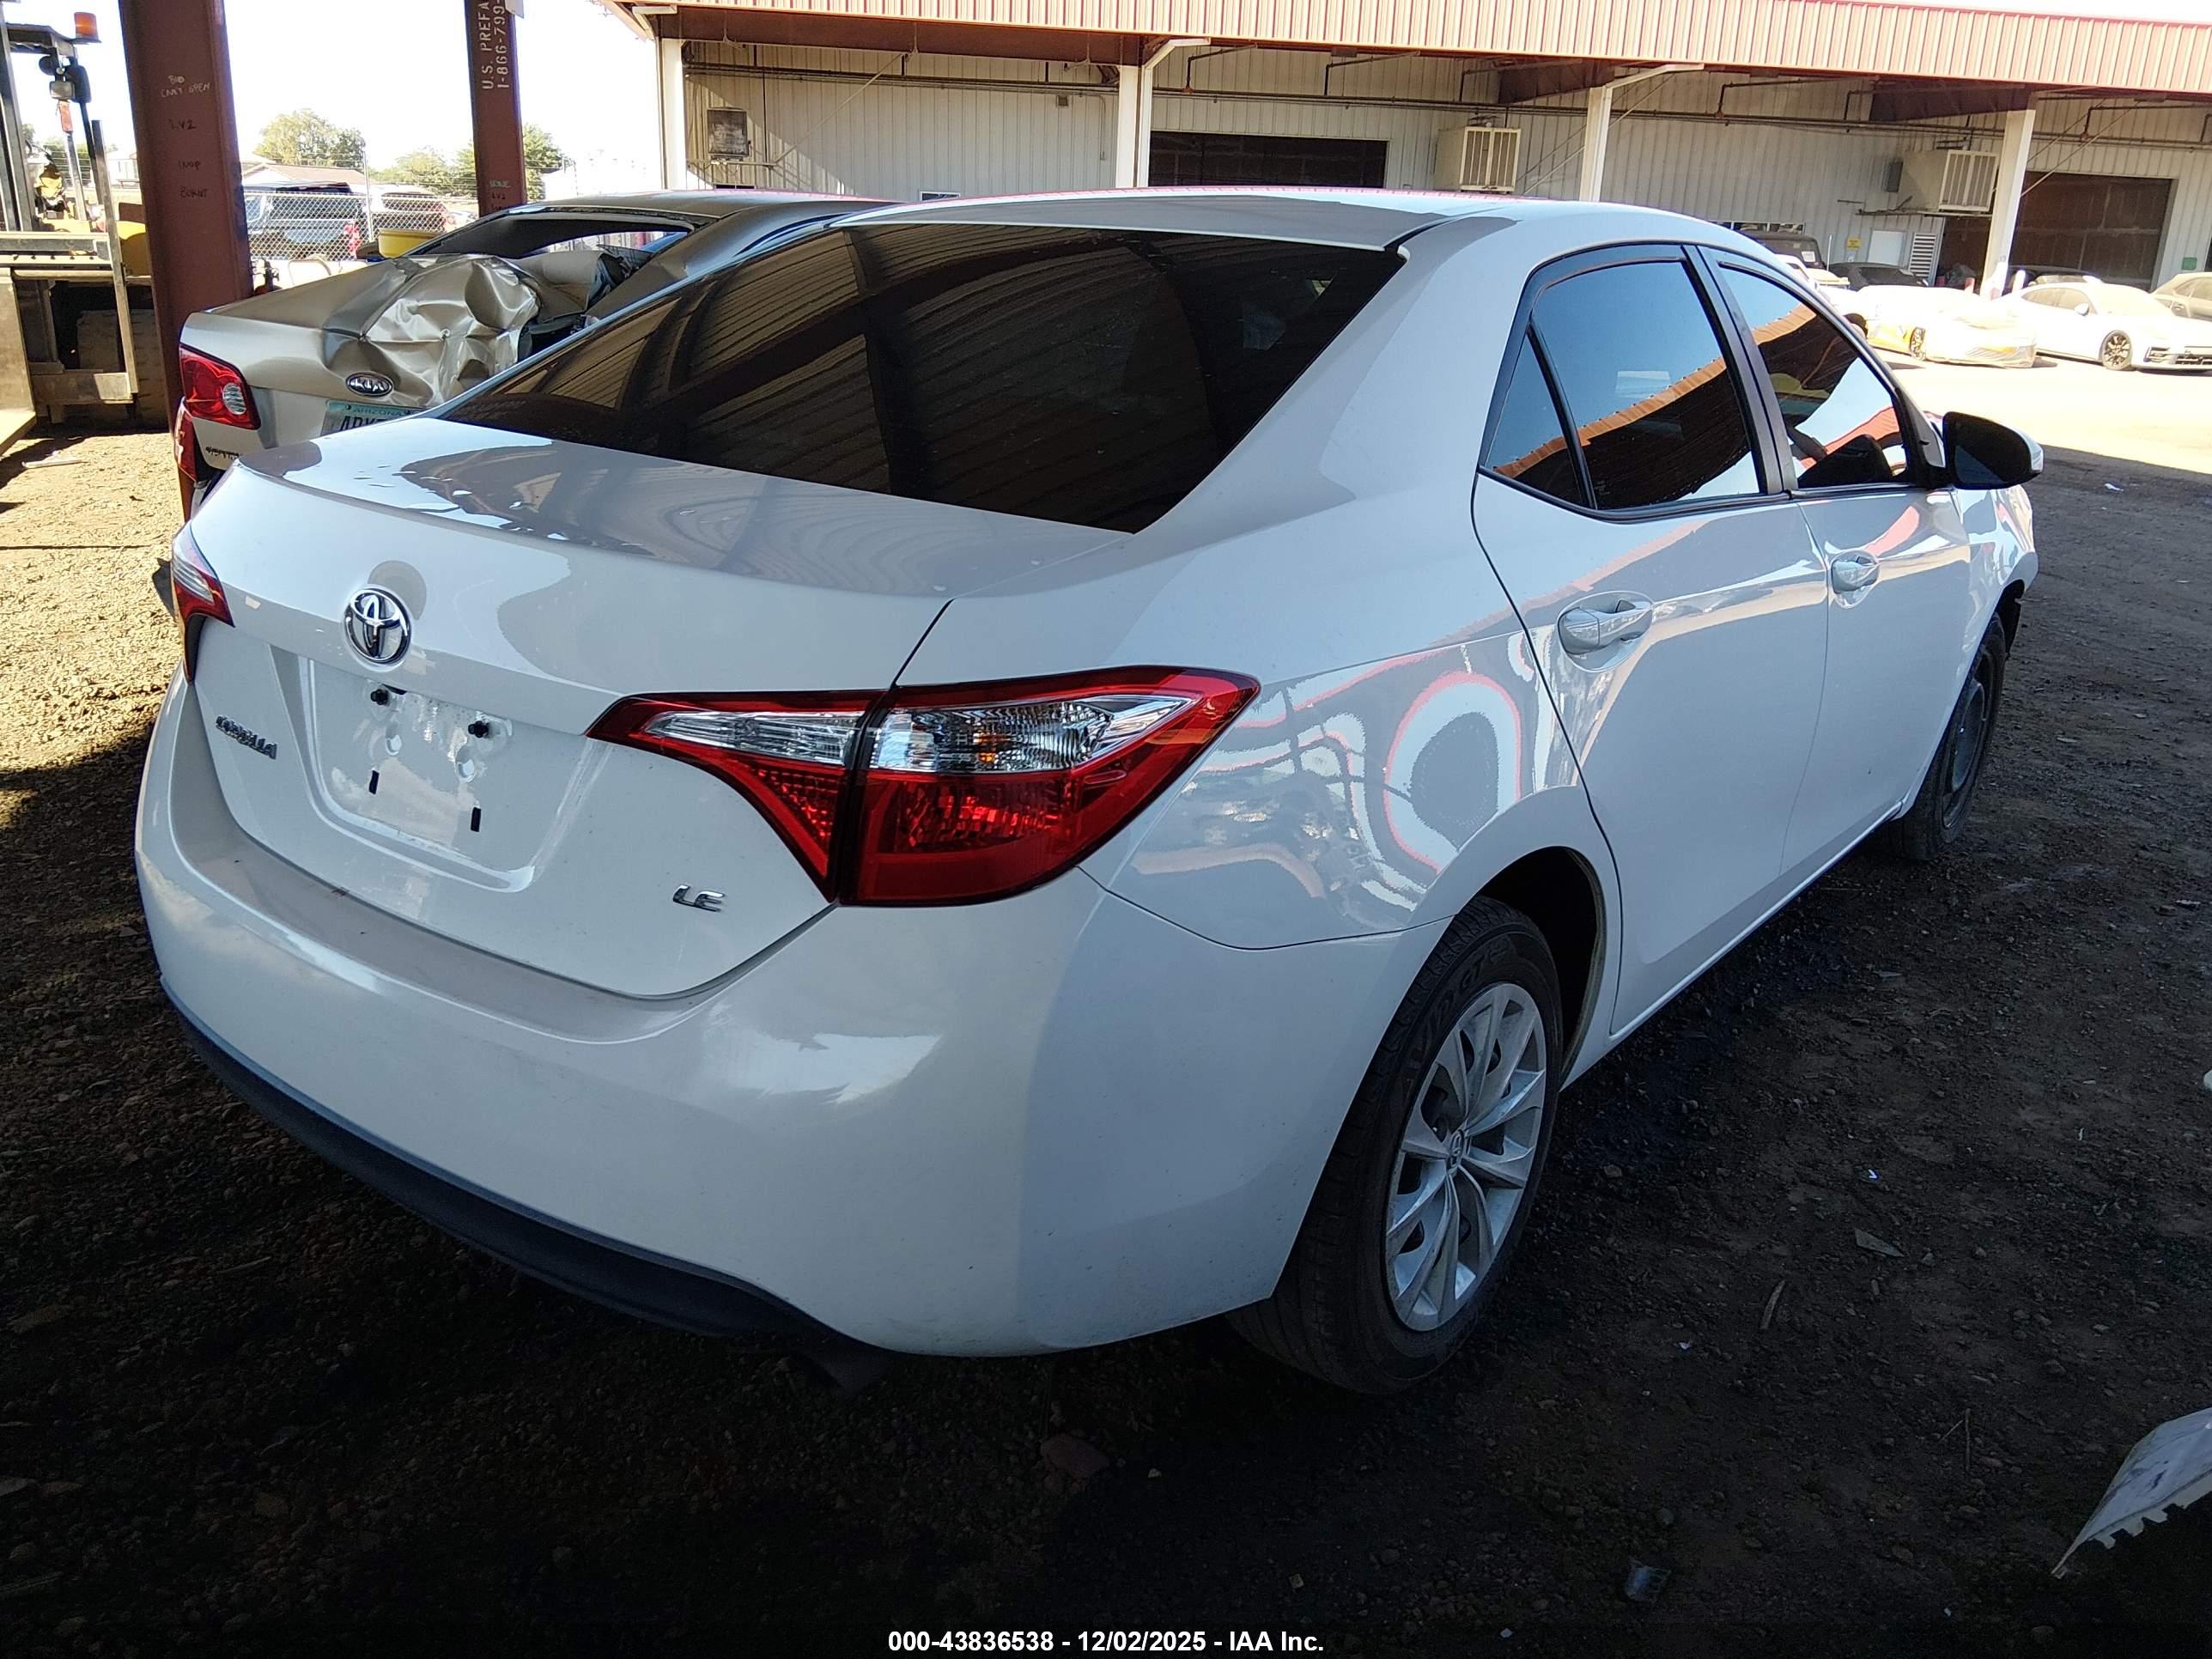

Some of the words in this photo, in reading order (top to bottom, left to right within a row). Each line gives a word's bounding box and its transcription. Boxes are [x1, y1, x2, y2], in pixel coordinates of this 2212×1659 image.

[481, 61, 495, 89] U.S.
[215, 715, 277, 761] COROLLA
[672, 884, 725, 913] LE
